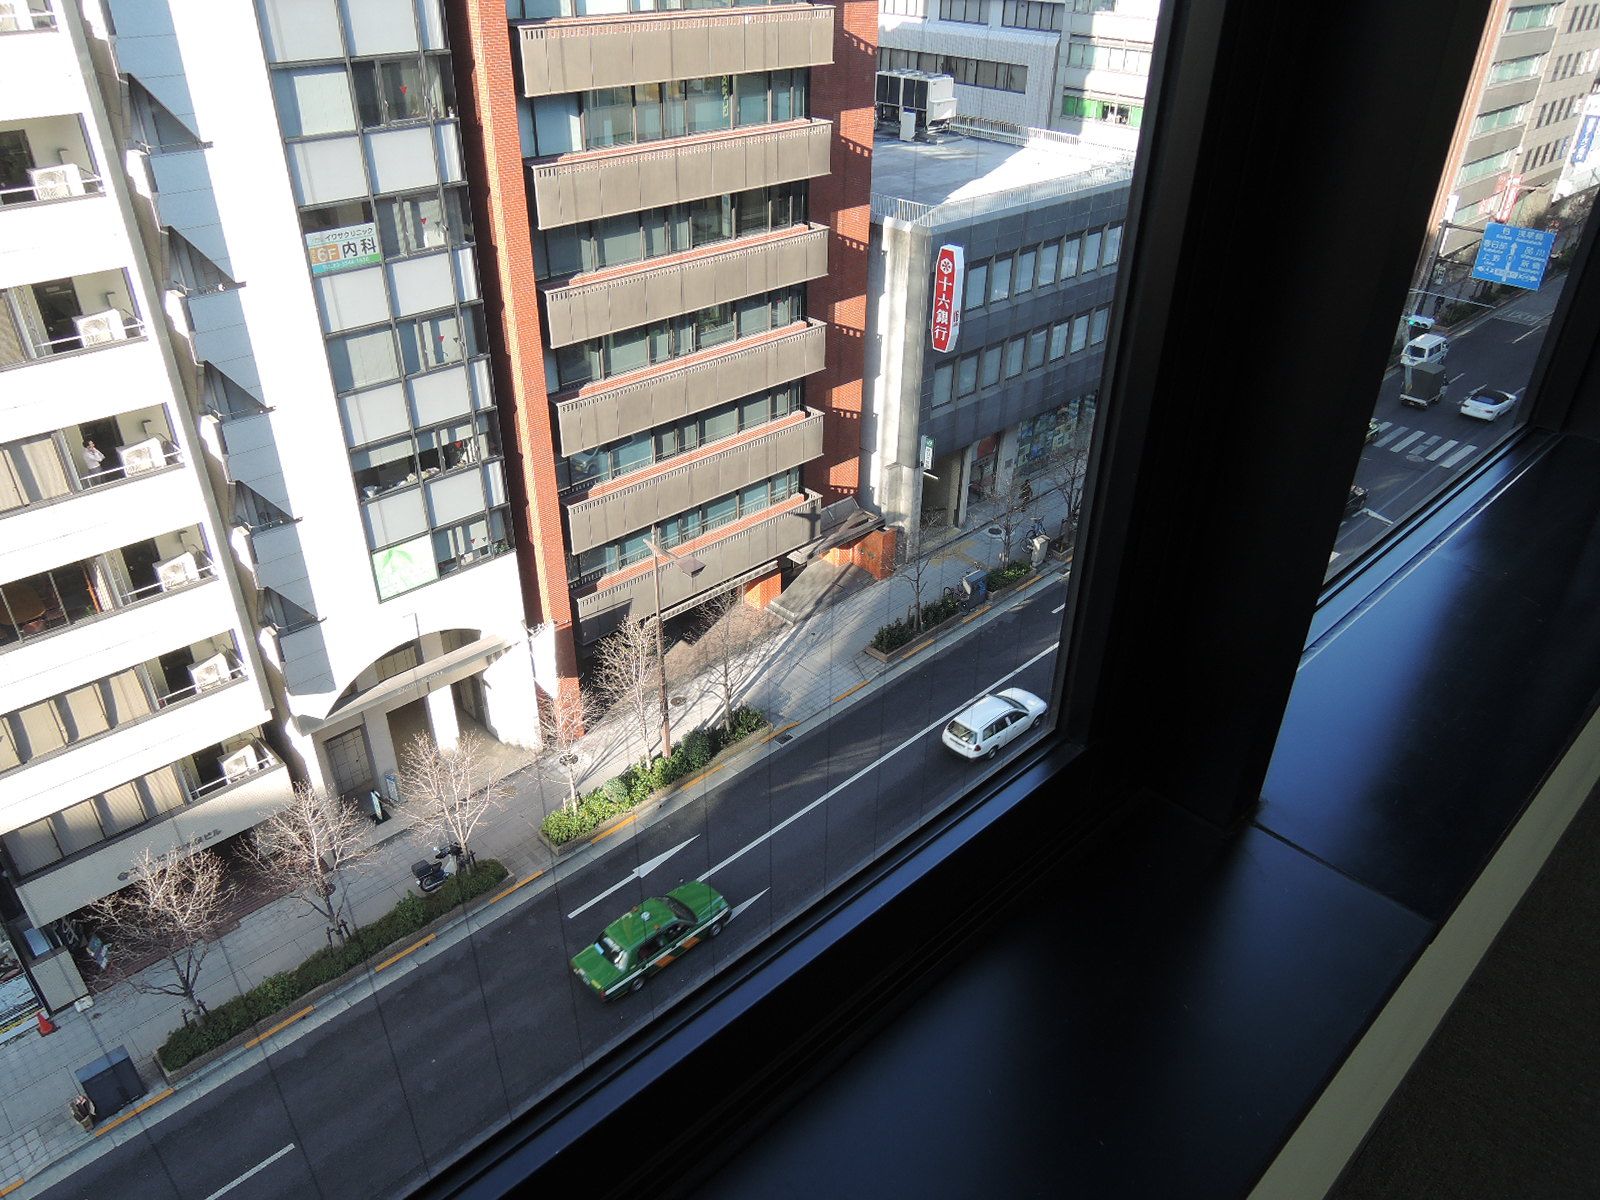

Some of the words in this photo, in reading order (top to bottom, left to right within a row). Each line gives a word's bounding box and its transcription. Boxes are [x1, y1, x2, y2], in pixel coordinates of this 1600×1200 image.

[342, 236, 377, 258] 内科
[934, 276, 953, 341] 十六銀行
